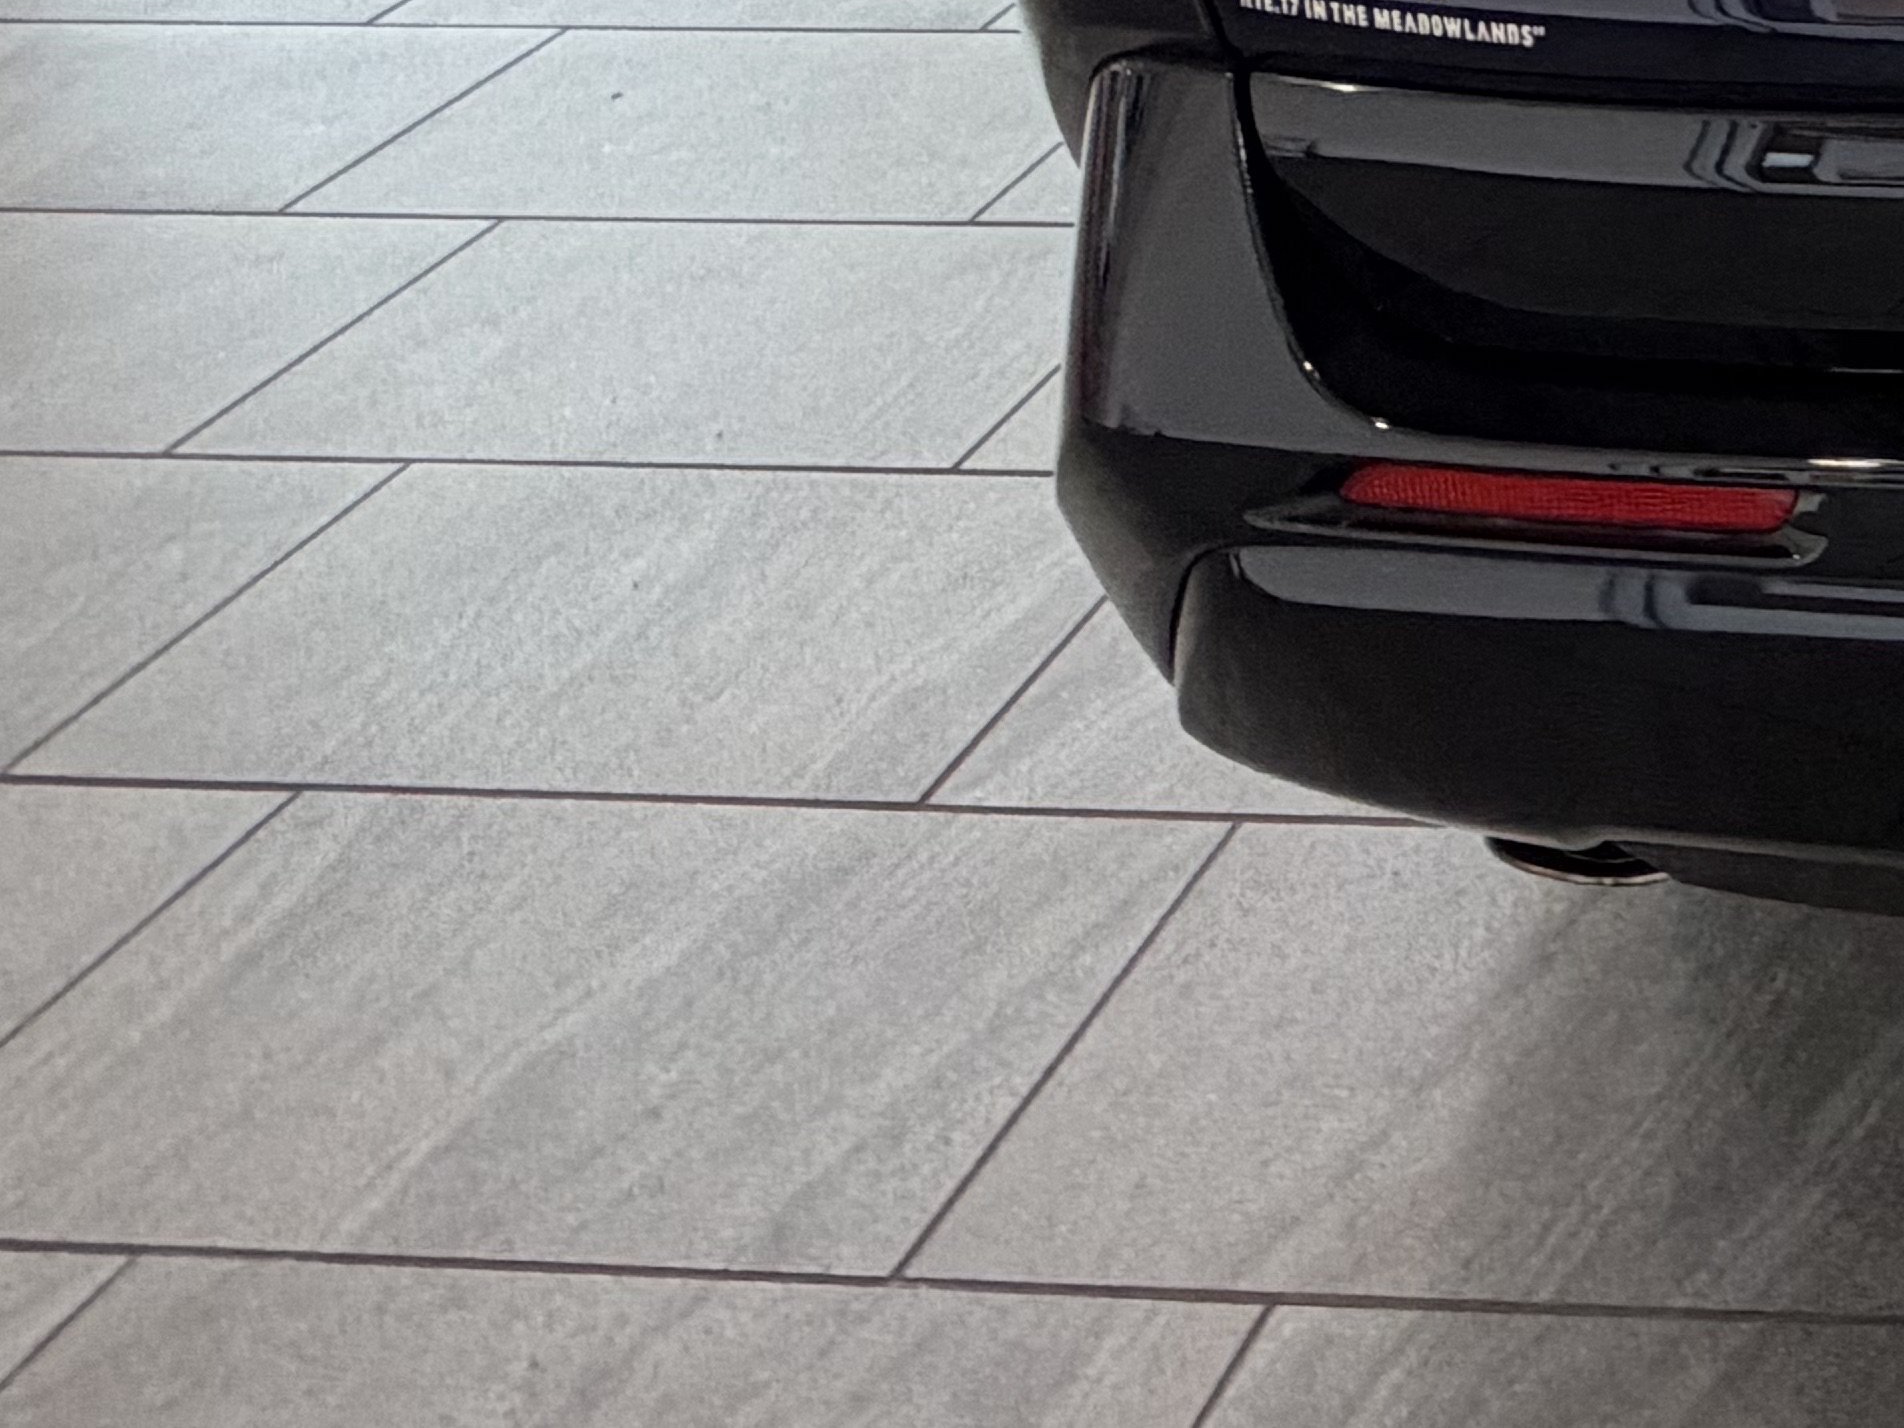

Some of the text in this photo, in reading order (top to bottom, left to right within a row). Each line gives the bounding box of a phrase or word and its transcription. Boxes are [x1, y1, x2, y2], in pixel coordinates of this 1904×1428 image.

[1304, 0, 1328, 22] IN
[1332, 1, 1369, 28] THE
[1374, 7, 1547, 49] MEADOWLANDS"
